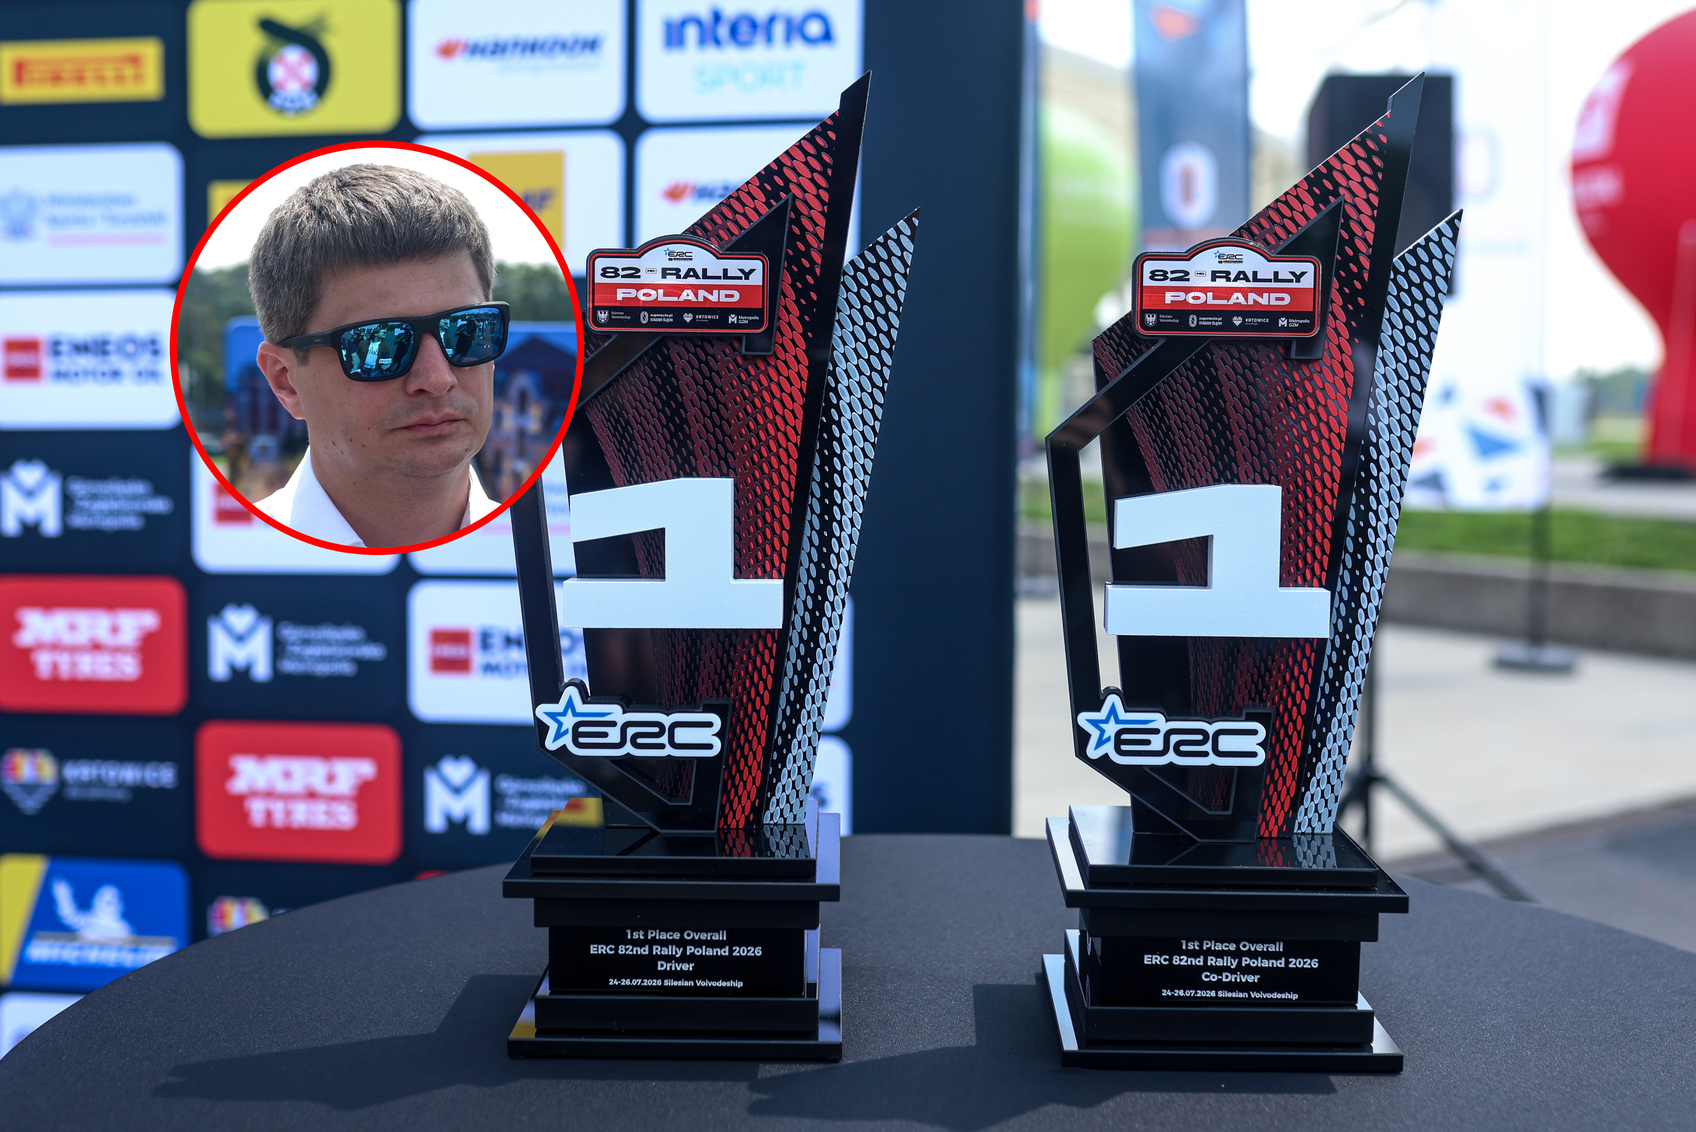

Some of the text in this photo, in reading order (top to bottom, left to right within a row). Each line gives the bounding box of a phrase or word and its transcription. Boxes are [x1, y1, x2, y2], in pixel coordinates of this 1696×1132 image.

[665, 9, 833, 49] interia
[600, 266, 641, 279] 82
[661, 267, 757, 280] RALLY
[1149, 269, 1190, 282] 82
[1210, 270, 1308, 283] RALLY
[616, 288, 740, 302] POLAND
[1164, 291, 1291, 306] POLAND
[52, 337, 161, 358] ENEOS
[563, 477, 783, 629] 1
[1103, 484, 1331, 638] 1
[15, 608, 160, 647] MRF
[32, 650, 142, 681] TYRES
[571, 720, 715, 750] ERC
[1114, 727, 1259, 758] ERC
[227, 755, 377, 795] MRF
[244, 798, 358, 830] TYRES
[626, 929, 727, 941] 1st Place Overall
[590, 944, 762, 957] ERC 82nd Rally Poland 2026
[1181, 940, 1284, 952] 1st Place Overall
[657, 960, 695, 971] Driver
[1144, 954, 1319, 968] ERC 82nd Rally Poland 2026
[609, 978, 743, 988] 24-26.07.2026 Silesian Voivodeship
[1201, 972, 1260, 982] Co-Driver
[1161, 989, 1298, 1000] 24-26.07.2026 Silesian Voivodeship
